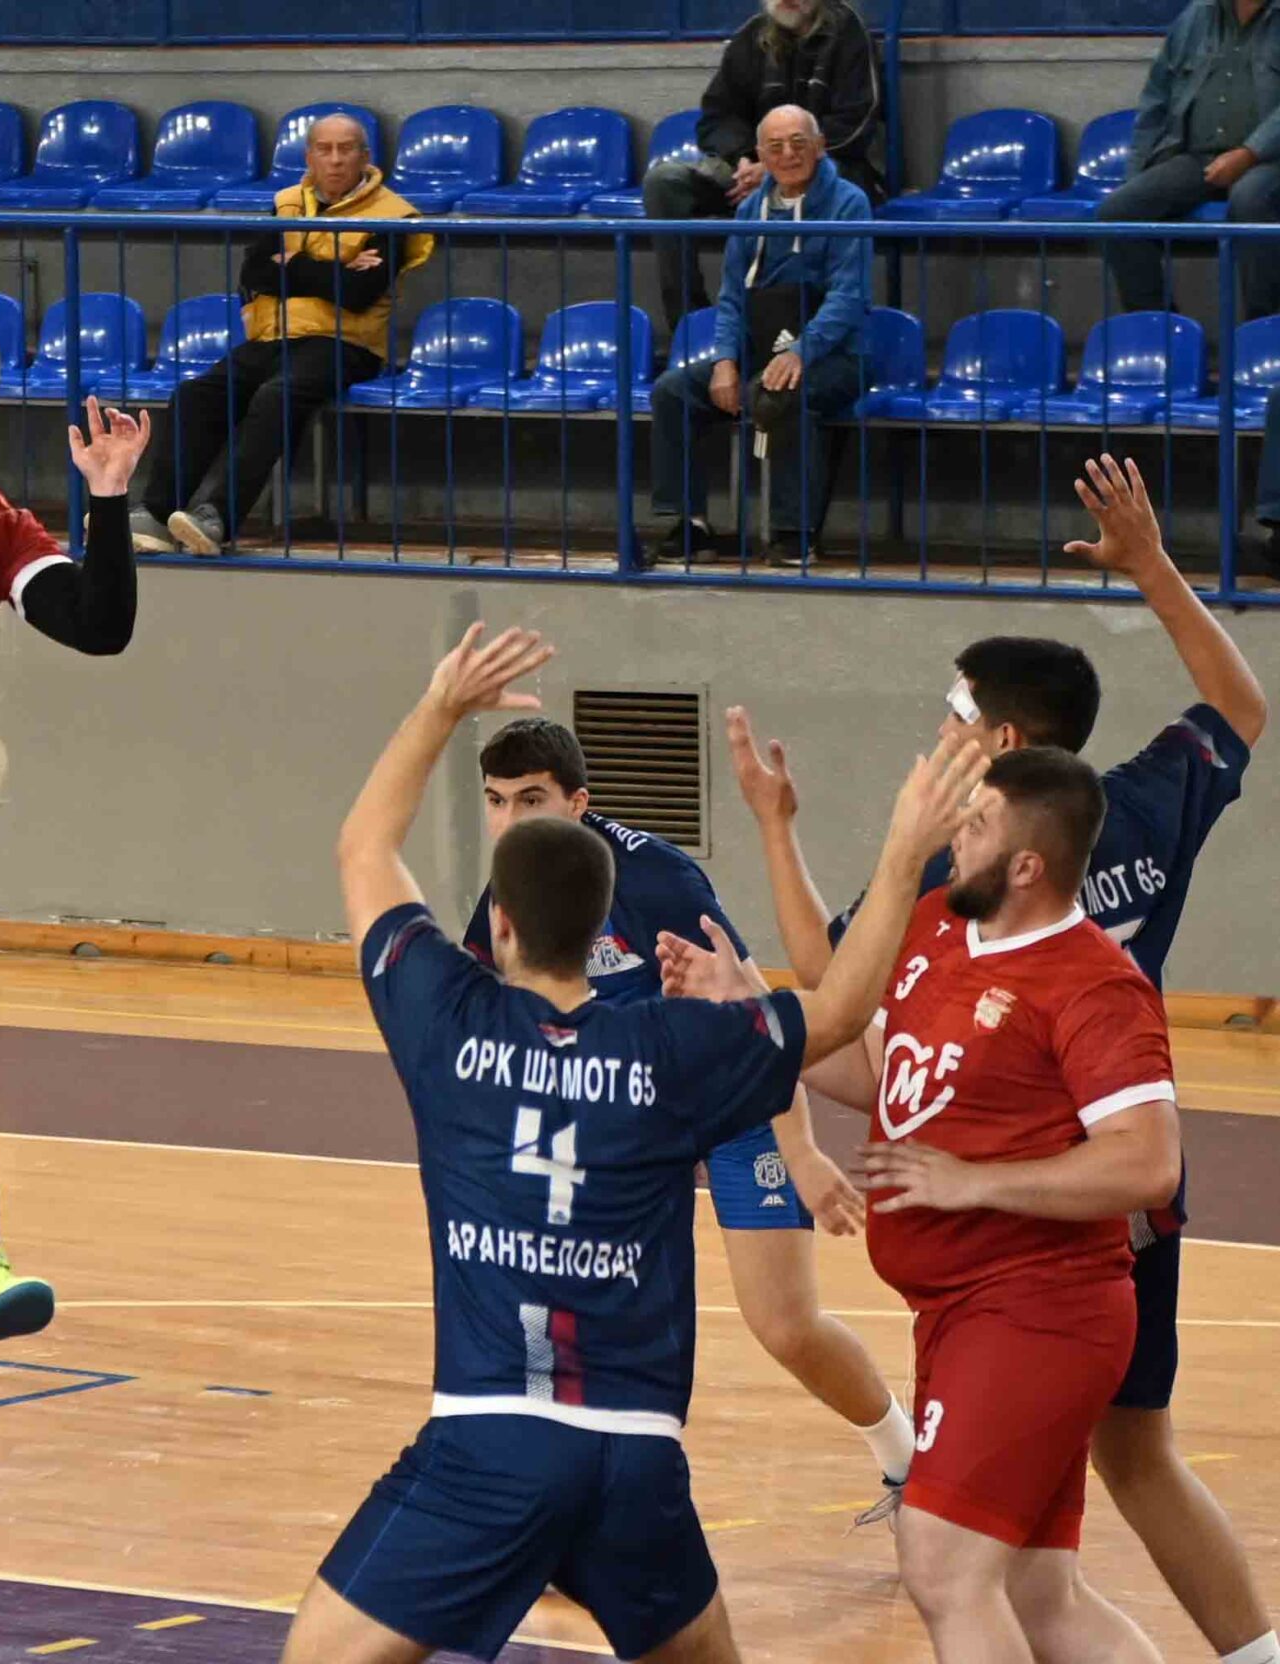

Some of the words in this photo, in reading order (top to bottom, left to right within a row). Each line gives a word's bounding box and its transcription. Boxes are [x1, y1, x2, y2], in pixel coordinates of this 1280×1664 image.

[1134, 857, 1166, 895] 65
[895, 955, 929, 1001] 3
[455, 1037, 516, 1087] ОРК
[522, 1047, 621, 1103] ШАМОТ
[628, 1060, 657, 1107] 65
[511, 1105, 586, 1225] 4
[916, 1399, 945, 1453] 3
